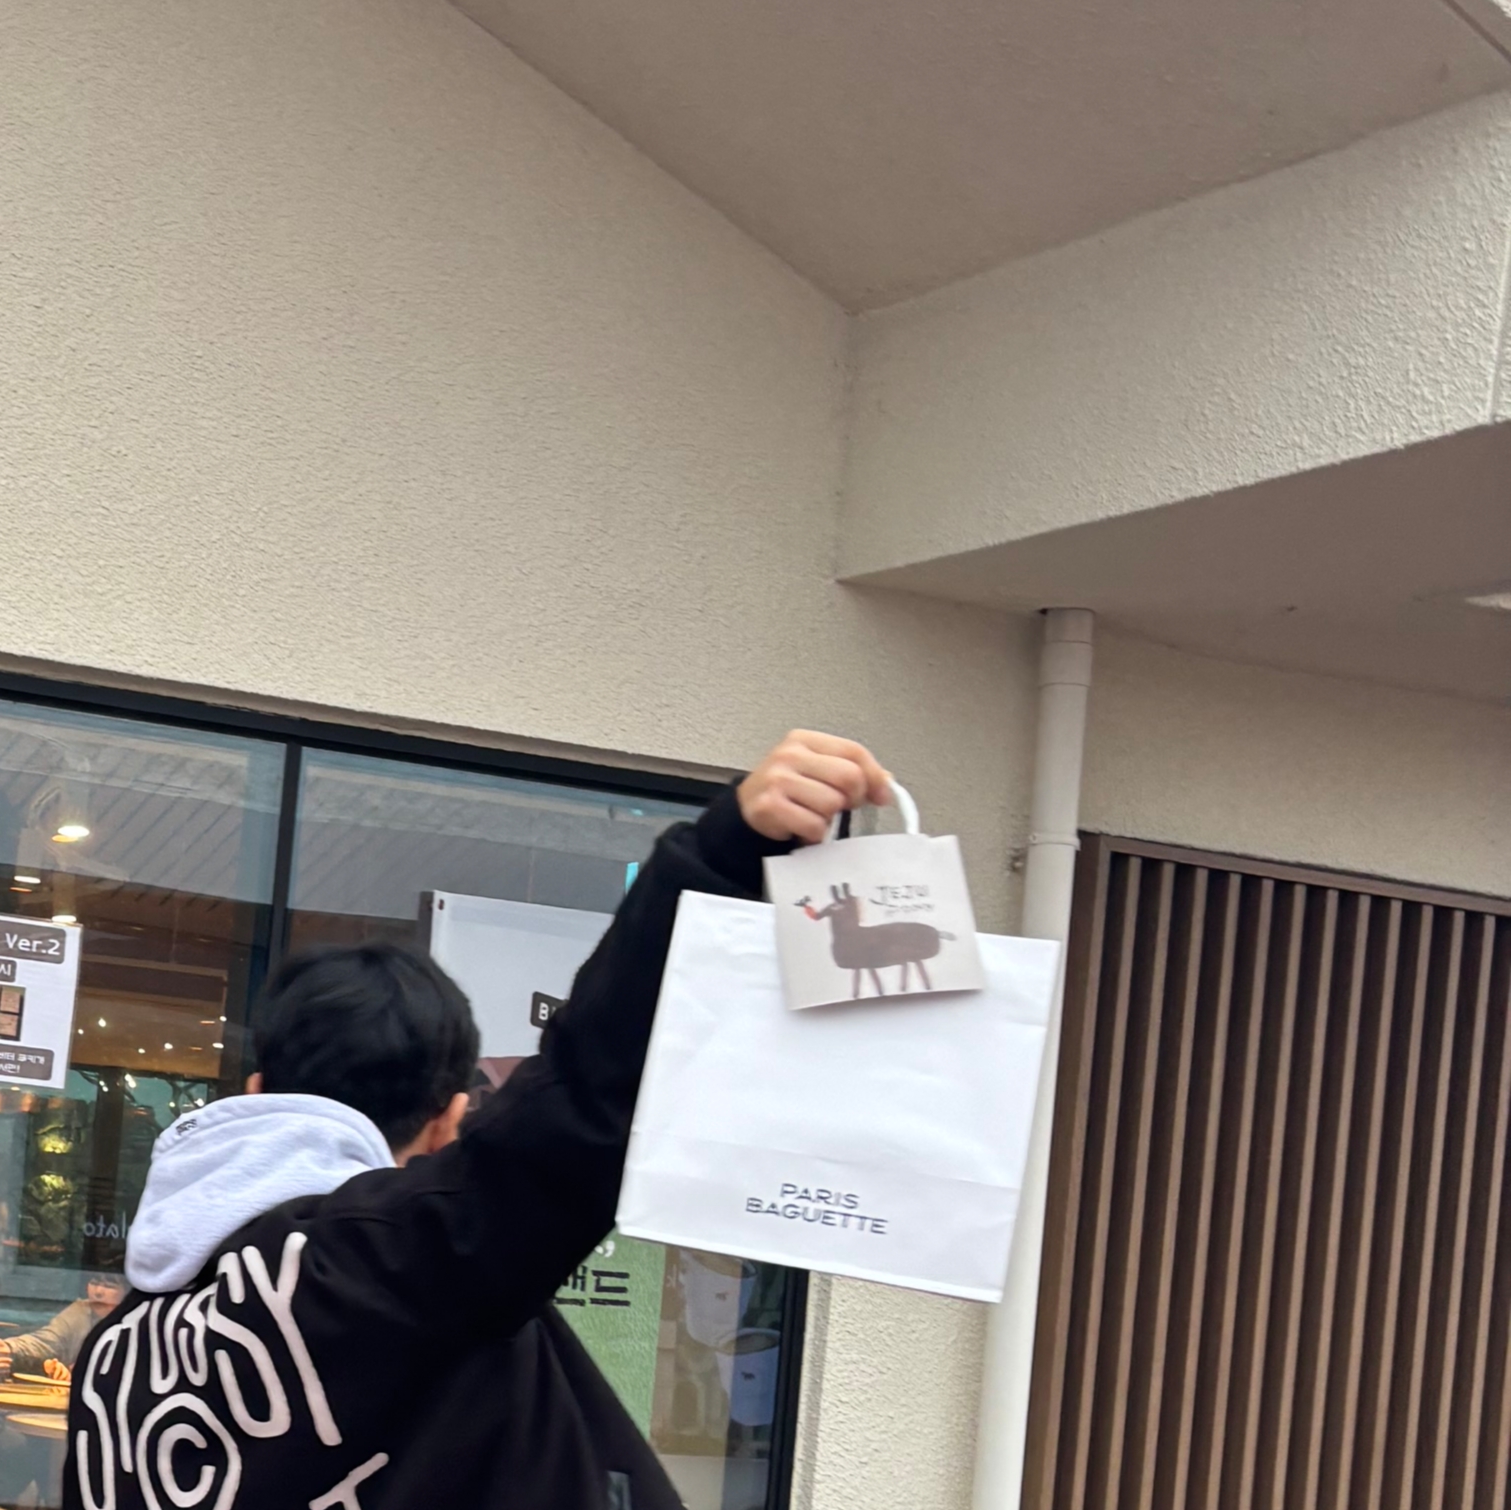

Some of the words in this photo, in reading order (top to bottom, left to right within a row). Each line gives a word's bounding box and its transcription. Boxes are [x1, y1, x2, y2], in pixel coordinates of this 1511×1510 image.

[5, 932, 61, 956] Ver.2
[780, 1183, 860, 1210] PARIS
[745, 1197, 889, 1235] BAGUETTE
